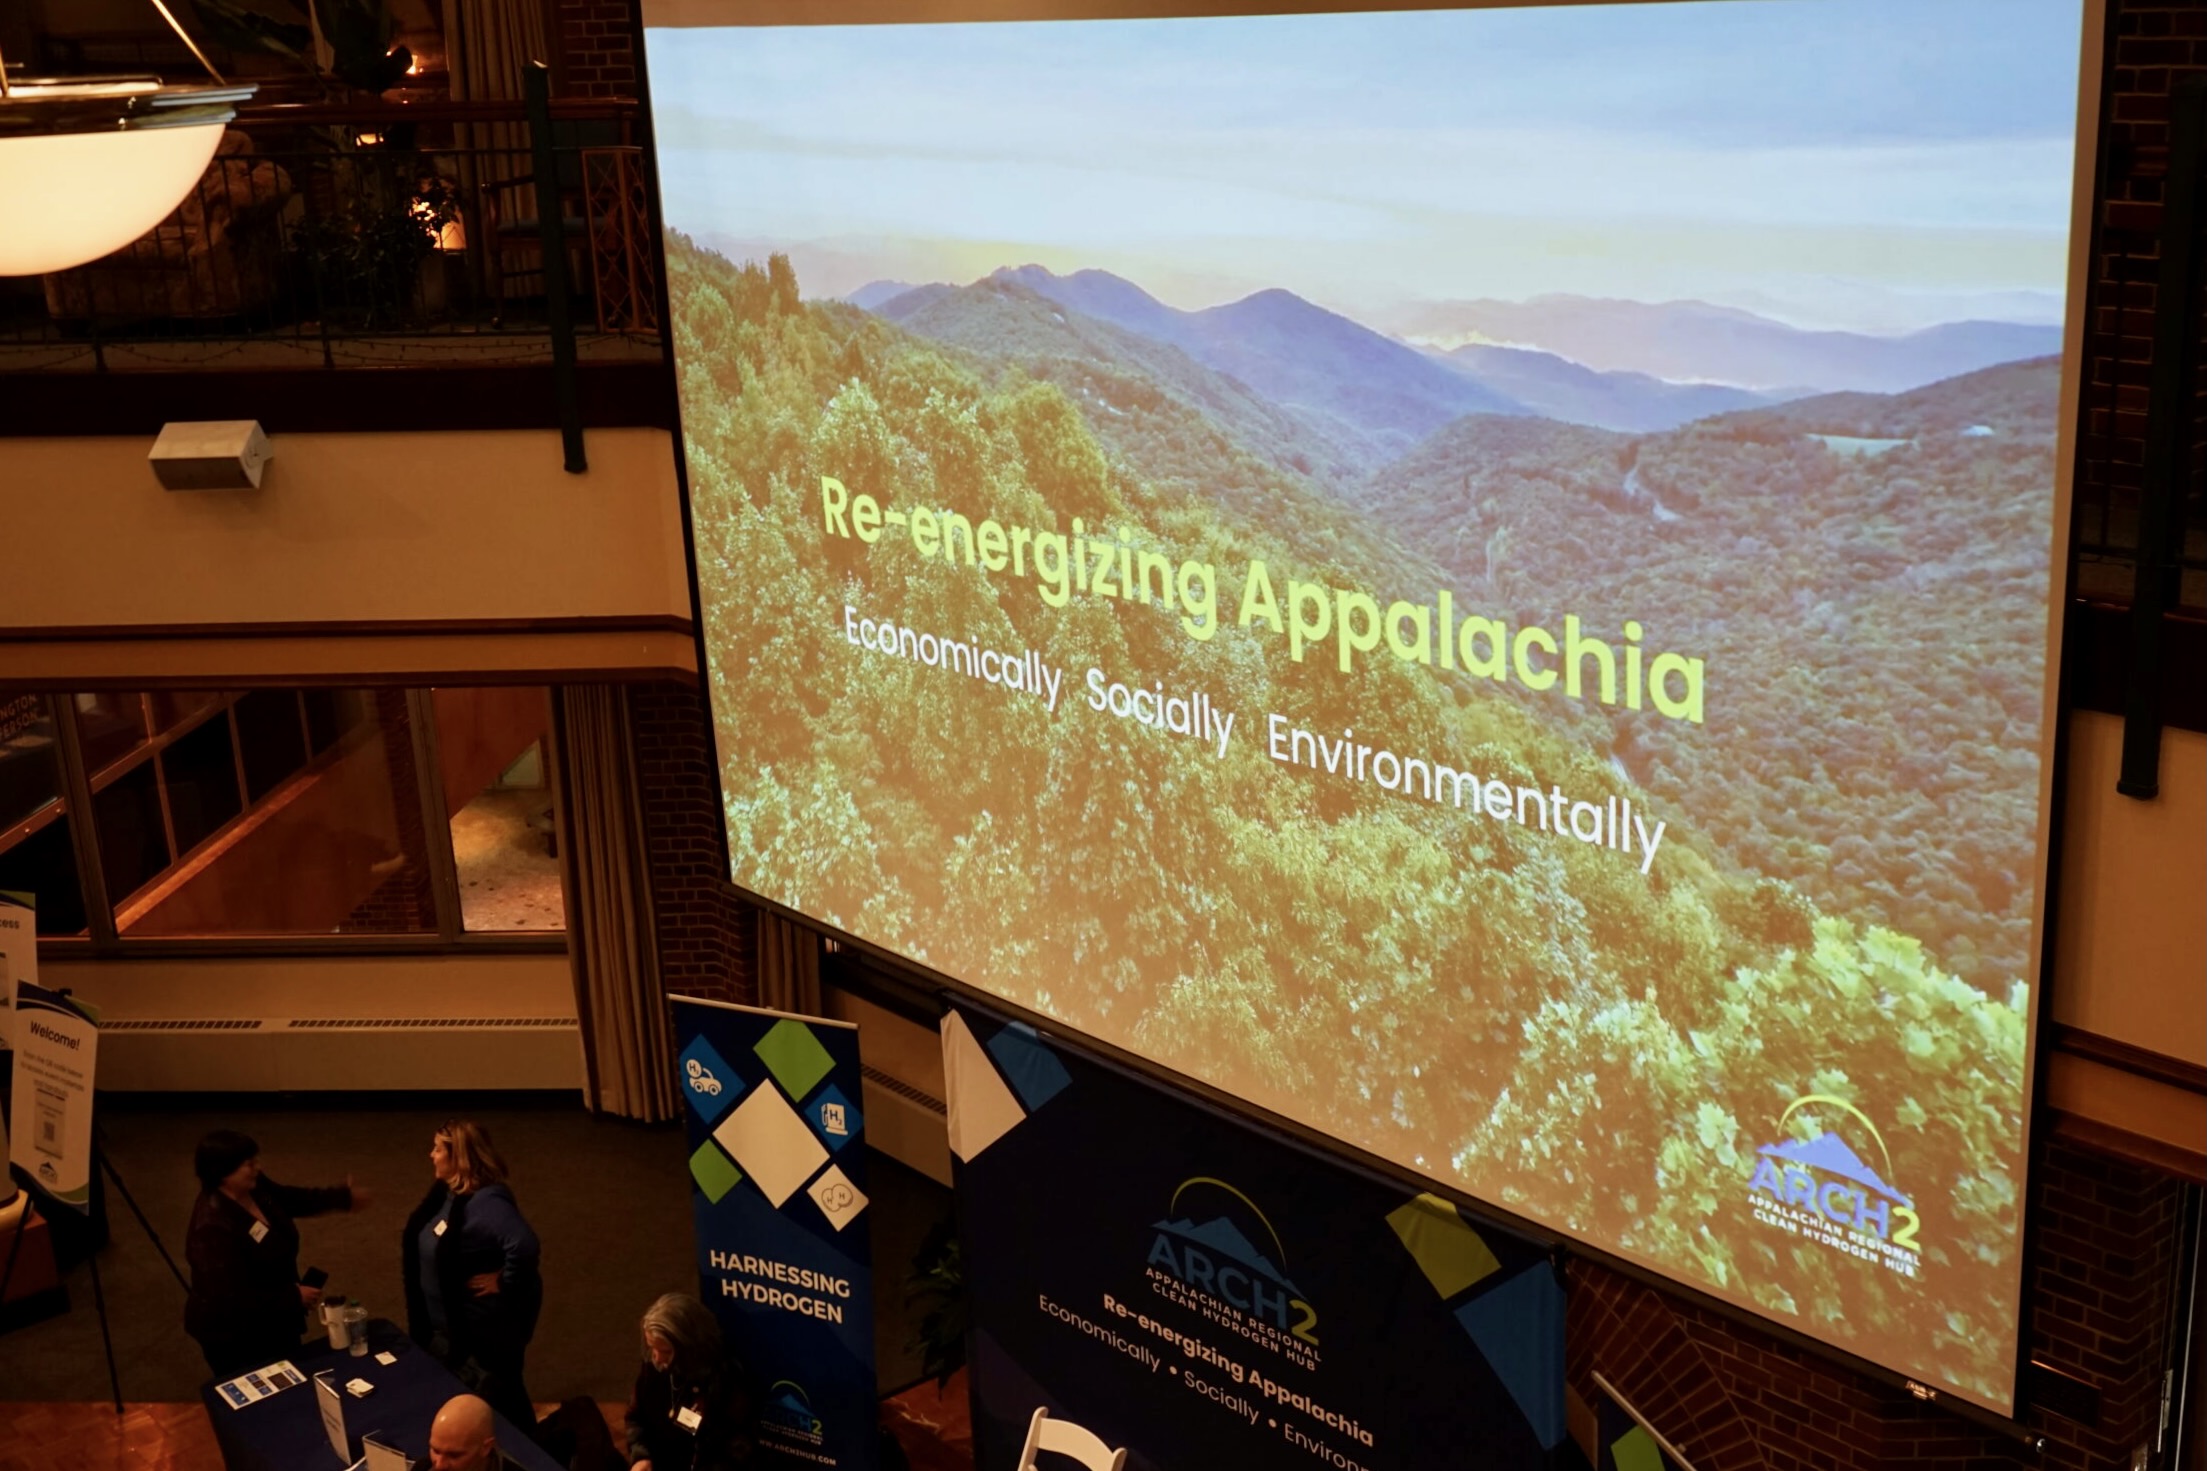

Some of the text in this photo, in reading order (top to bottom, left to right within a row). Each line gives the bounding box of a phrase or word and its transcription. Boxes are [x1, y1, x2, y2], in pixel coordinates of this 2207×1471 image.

[821, 475, 1705, 724] Re-energizing Appalachia
[844, 605, 1666, 876] Economically Socially Environmentally
[30, 1020, 81, 1051] Welcome!
[1747, 1194, 1921, 1267] APPALACHIAN REGIONAL
[1748, 1157, 1921, 1252] ARCH2
[1753, 1208, 1916, 1278] CLEAN HYDROGEN HUB
[710, 1249, 851, 1299] HARNESSING
[721, 1278, 843, 1325] HYDROGEN
[1145, 1267, 1323, 1363] APPALACHIAN REGIONAL
[1146, 1233, 1320, 1346] ARCH2
[1104, 1293, 1375, 1448] Re-energizing Appalachia
[1152, 1282, 1316, 1372] CLEAN HYDROGEN HUB
[1039, 1294, 1370, 1471] Economically Socially Environ
